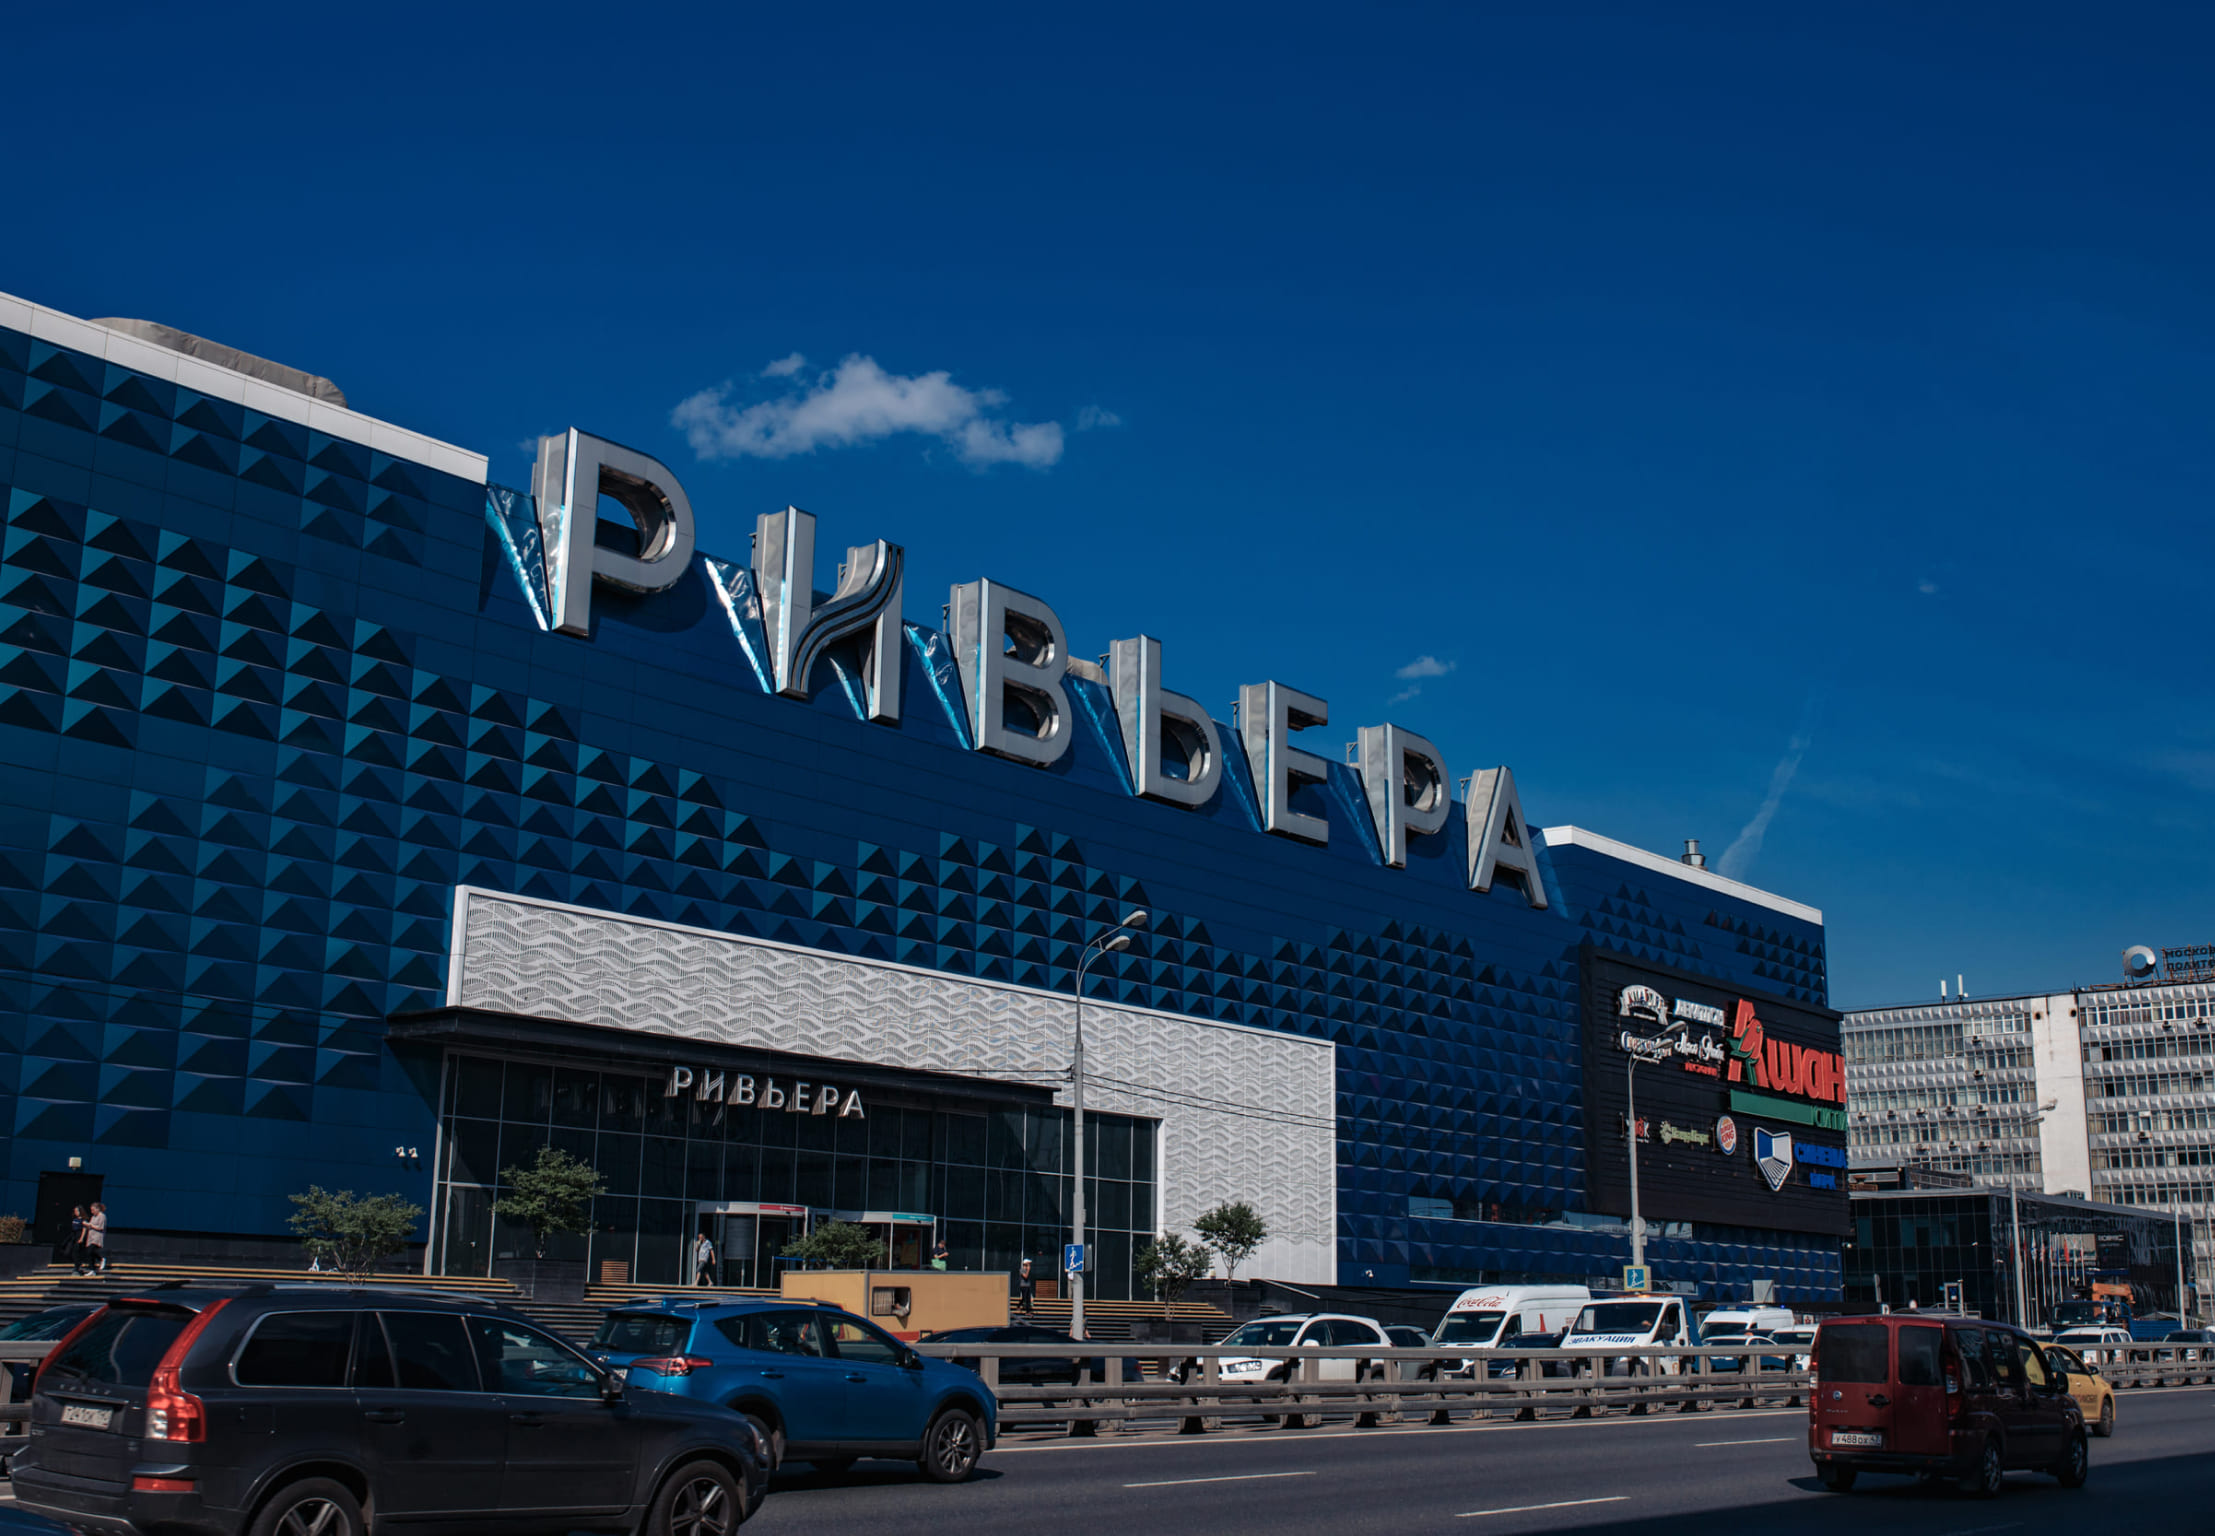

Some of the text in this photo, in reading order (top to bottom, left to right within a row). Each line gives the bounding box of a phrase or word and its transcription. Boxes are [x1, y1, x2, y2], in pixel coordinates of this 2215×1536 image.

[533, 426, 1548, 909] РИВЬЕРА
[665, 1065, 866, 1120] РИВЬЕРА
[1720, 1129, 1735, 1145] KING
[1567, 1335, 1636, 1345] ЭВАКУАЦИЯ
